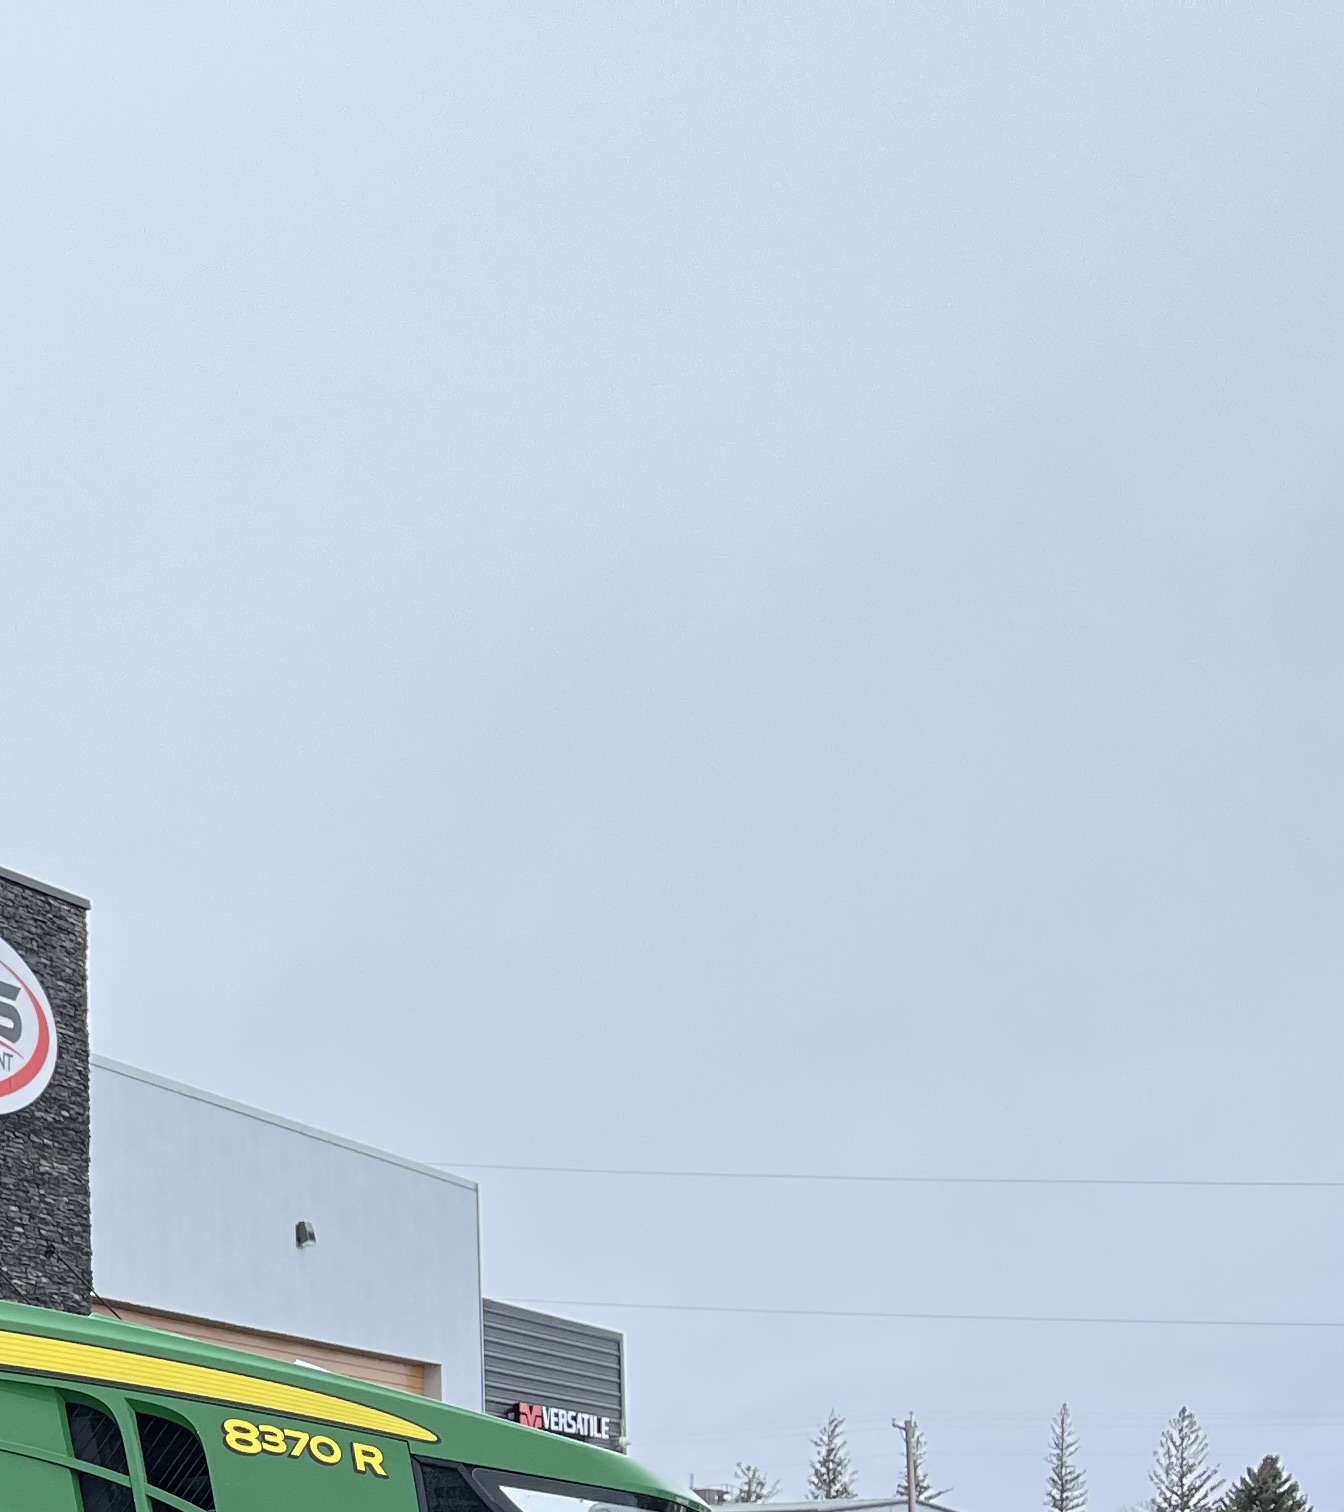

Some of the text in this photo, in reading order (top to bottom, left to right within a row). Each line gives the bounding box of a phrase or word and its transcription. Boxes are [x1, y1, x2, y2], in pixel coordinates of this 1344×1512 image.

[542, 1405, 610, 1440] VERSATILE
[223, 1418, 389, 1479] 8370 R
